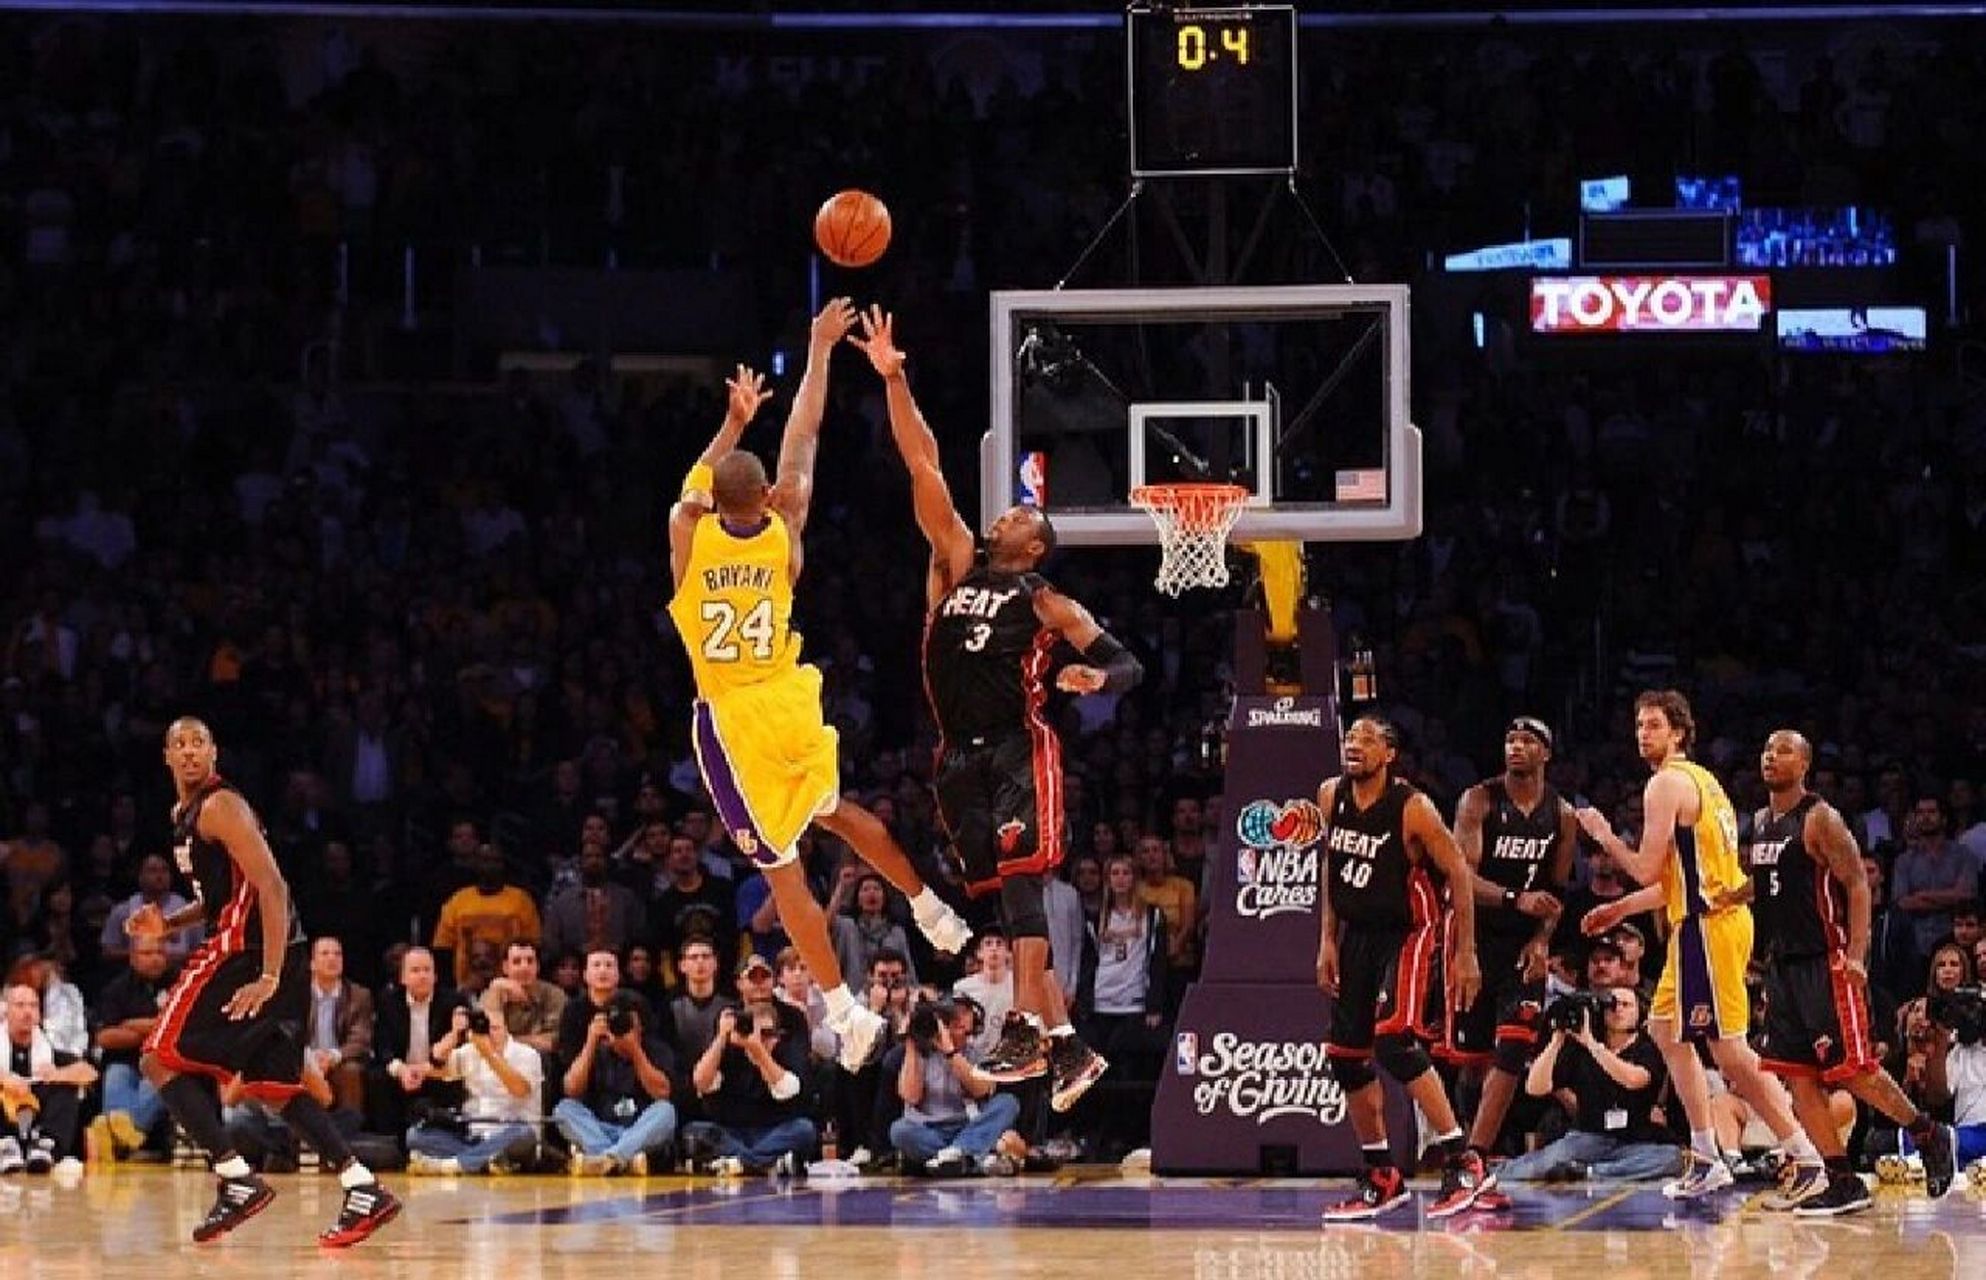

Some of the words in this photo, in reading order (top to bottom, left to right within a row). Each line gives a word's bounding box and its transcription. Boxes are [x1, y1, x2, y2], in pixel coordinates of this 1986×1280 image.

[1178, 26, 1247, 69] 0.4
[1534, 279, 1763, 327] TOYOTA
[703, 564, 773, 592] BRYANT
[701, 598, 775, 663] 24
[964, 622, 992, 652] 3
[1248, 708, 1322, 728] SPALDING
[1330, 826, 1391, 859] HEAT
[1493, 833, 1556, 859] HEAT
[1257, 848, 1318, 884] NBA
[1339, 857, 1373, 889] 40
[1236, 882, 1318, 916] Cares
[1769, 871, 1780, 897] 5
[1194, 1075, 1231, 1116] of
[1228, 1069, 1347, 1126] Giving
